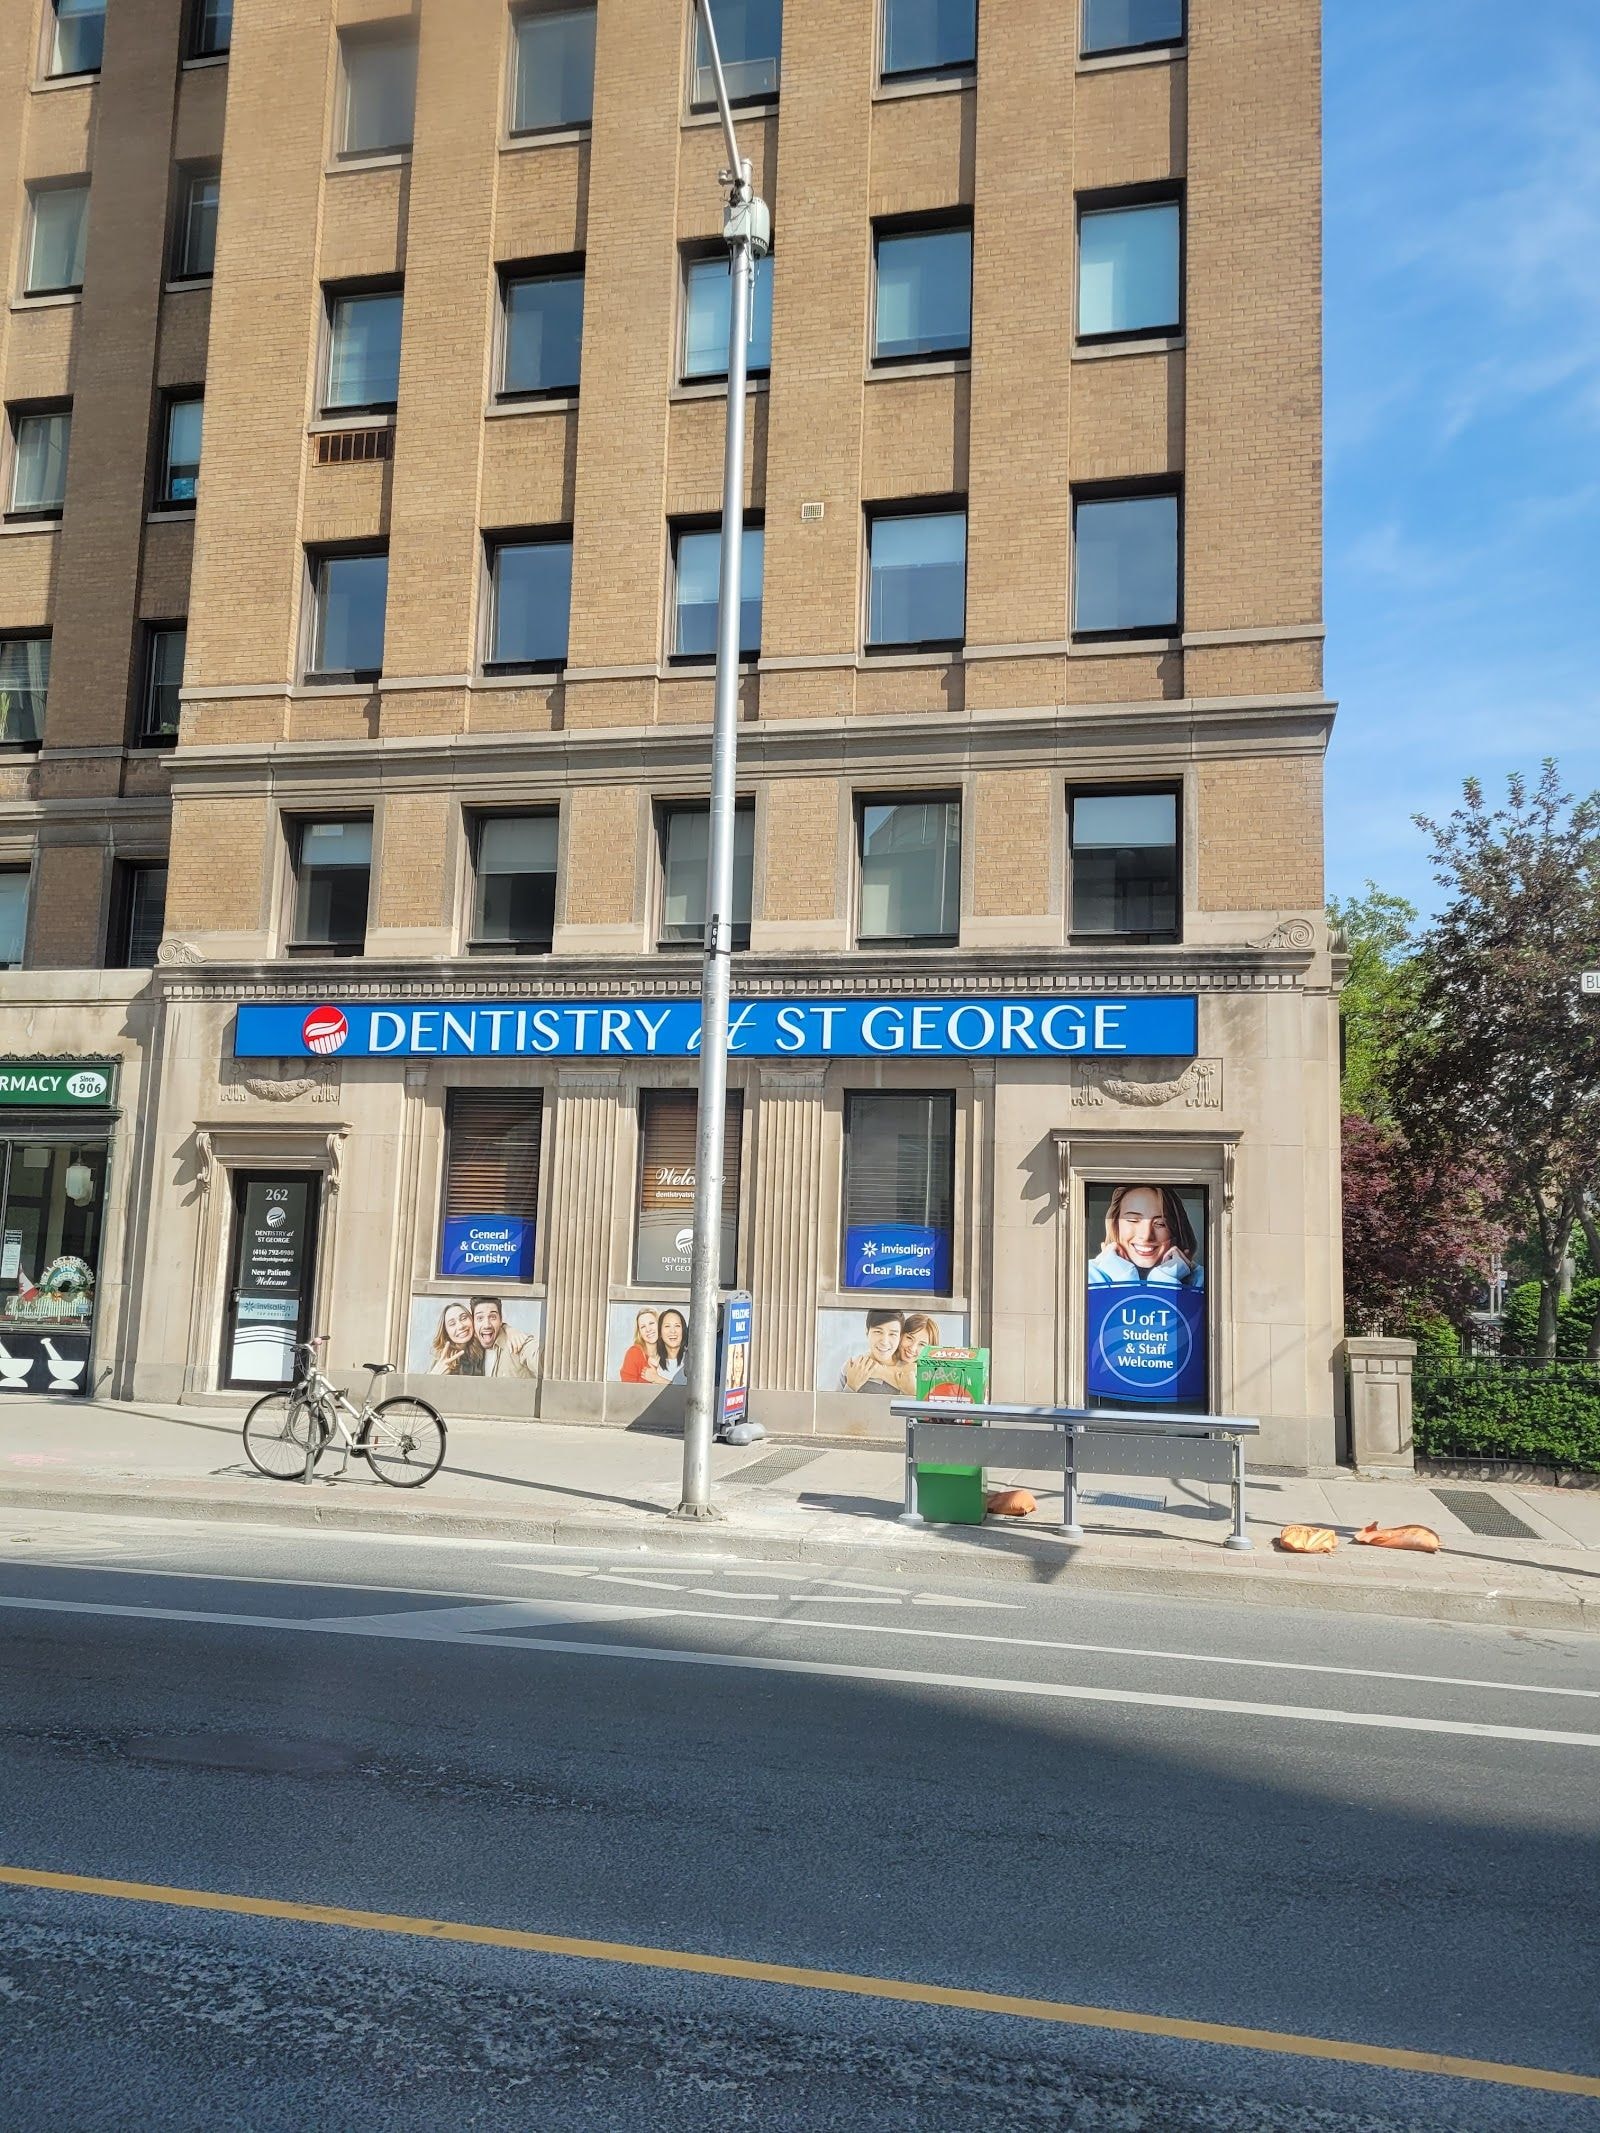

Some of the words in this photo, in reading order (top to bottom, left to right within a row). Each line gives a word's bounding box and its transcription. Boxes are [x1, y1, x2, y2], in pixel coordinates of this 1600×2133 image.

[368, 1008, 672, 1053] DENTISTRY
[774, 1006, 846, 1052] ST
[861, 1004, 1127, 1051] GEORGE
[79, 1075, 95, 1083] Since
[71, 1083, 102, 1093] 1906
[265, 1188, 289, 1201] 262
[469, 1228, 509, 1240] General
[460, 1240, 469, 1251] &
[471, 1241, 517, 1252] Cosmetic
[881, 1243, 931, 1257] invisalign
[465, 1252, 511, 1267] Dentistry
[59, 1263, 77, 1273] THIS
[251, 1268, 266, 1276] New
[267, 1268, 291, 1276] Patients
[862, 1263, 892, 1276] Clear
[895, 1264, 931, 1277] Braces
[256, 1277, 288, 1286] Welcome
[257, 1302, 291, 1312] invisalign
[1122, 1308, 1136, 1325] U
[1139, 1310, 1156, 1326] of
[1157, 1310, 1170, 1326] T
[1122, 1329, 1169, 1342] Student
[1125, 1342, 1135, 1354] &
[1138, 1343, 1167, 1355] Staff
[1117, 1355, 1174, 1369] Welcome
